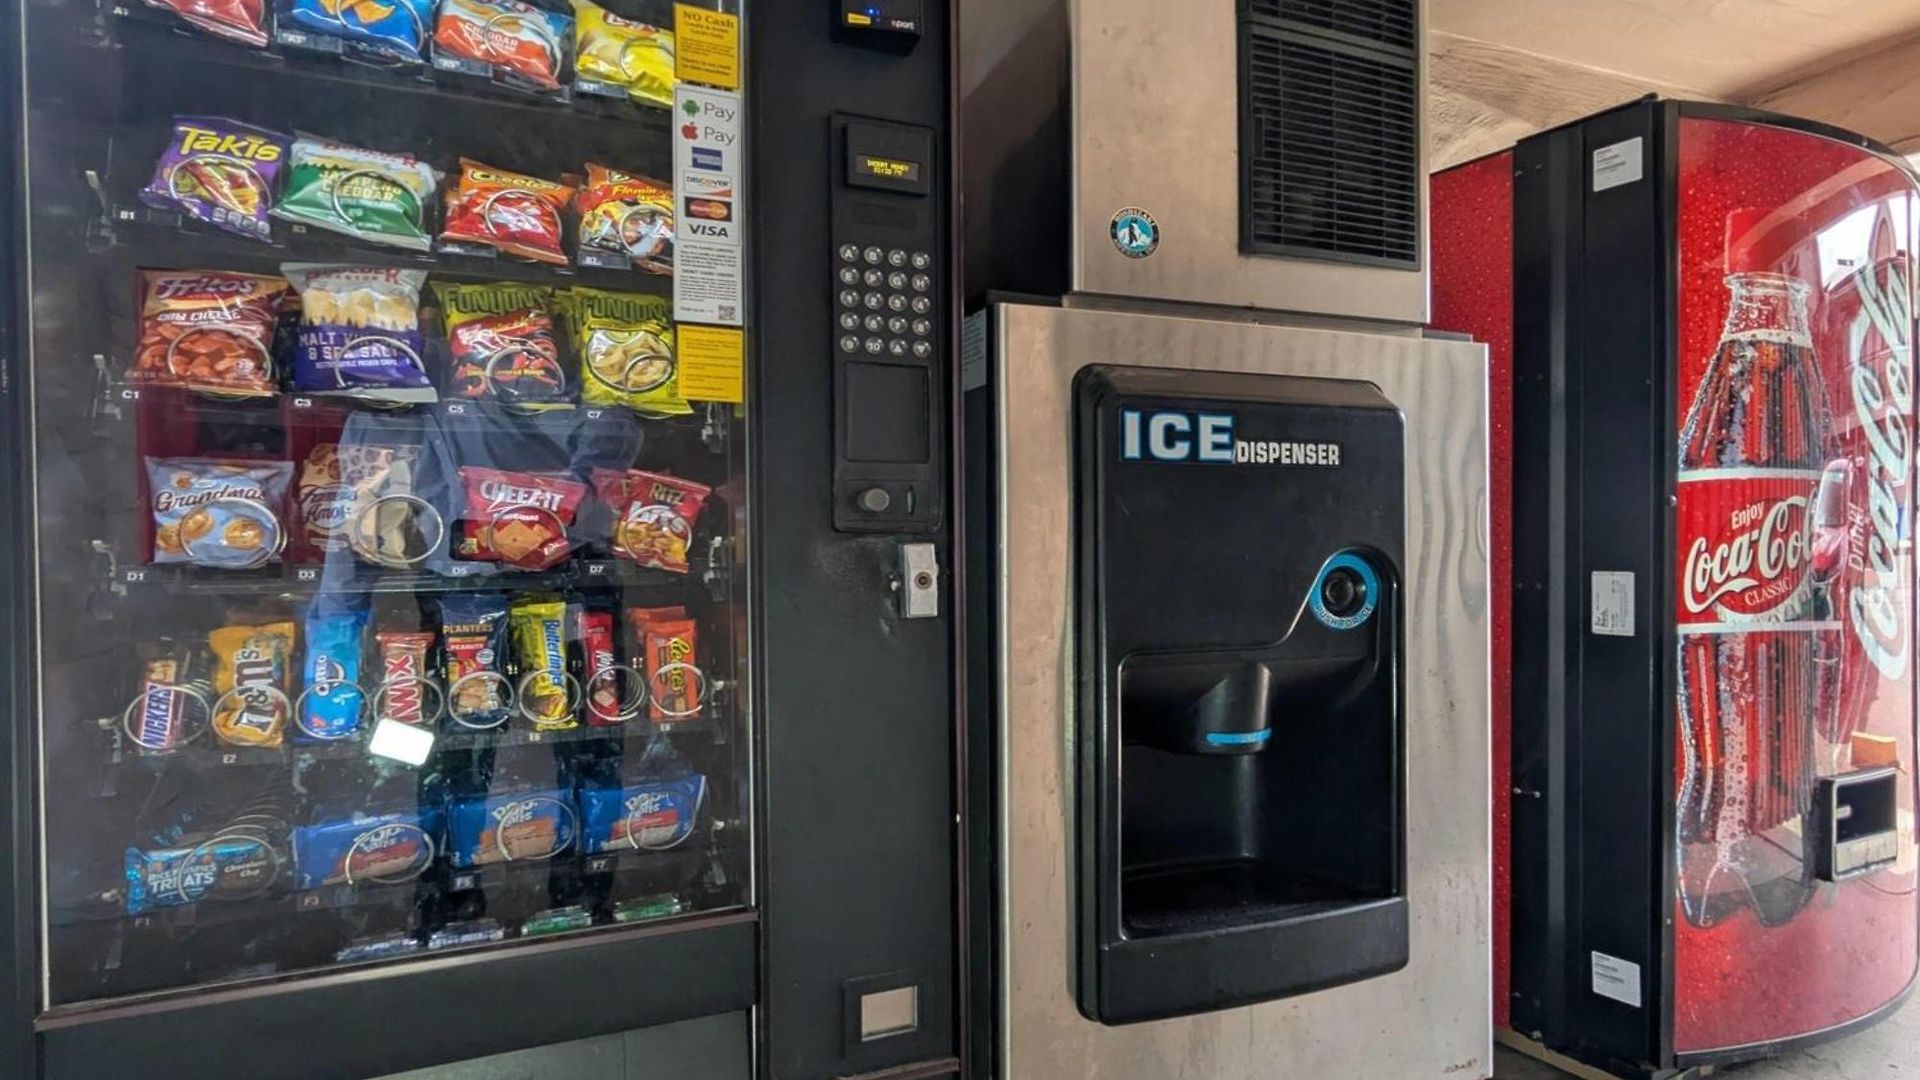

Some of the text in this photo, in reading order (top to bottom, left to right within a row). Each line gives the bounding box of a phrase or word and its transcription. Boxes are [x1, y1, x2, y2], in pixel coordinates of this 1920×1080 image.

[704, 14, 735, 29] Cash
[704, 102, 735, 122] Pay
[178, 127, 281, 161] Takis
[704, 126, 735, 146] Pay
[322, 180, 394, 202] CEDDAR
[686, 175, 729, 187] DISCOVER
[688, 223, 729, 238] VISA
[157, 277, 257, 299] Fritos
[122, 390, 140, 399] C1
[294, 399, 312, 408] C3
[448, 405, 464, 414] C5
[587, 411, 602, 419] C7
[1123, 410, 1340, 466] ICE DISPENSER
[649, 482, 685, 503] RITZ
[1731, 501, 1764, 530] Enjoy
[1684, 487, 1817, 613] Coca-Col
[127, 572, 144, 581] D1
[589, 565, 604, 574] D7
[1744, 577, 1793, 606] CLASSIC
[442, 624, 494, 634] PLANTERS
[141, 685, 172, 747] NICKERS
